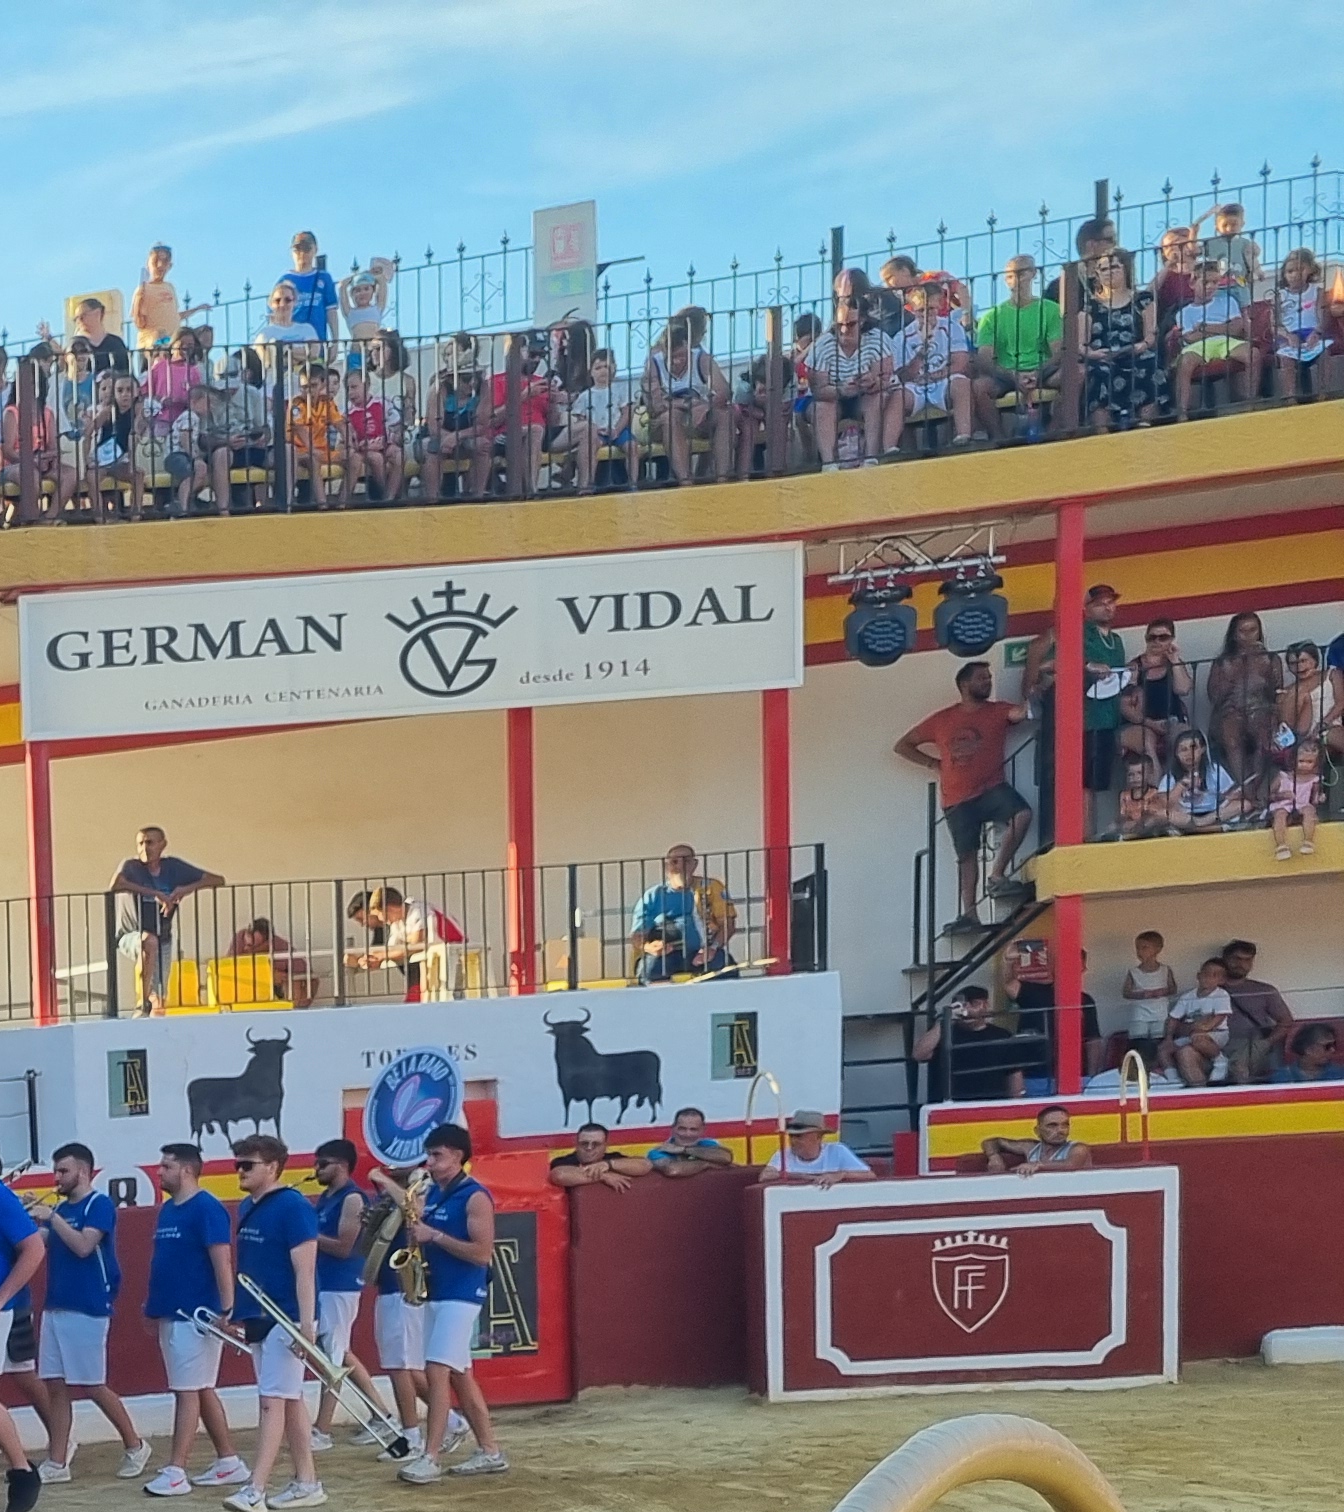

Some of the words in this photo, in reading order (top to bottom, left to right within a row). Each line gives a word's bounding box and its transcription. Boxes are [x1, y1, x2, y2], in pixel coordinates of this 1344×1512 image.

[46, 613, 347, 672] GERMAN
[556, 584, 775, 635] VIDAL
[519, 667, 574, 685] desde
[583, 657, 652, 680] 1914
[144, 693, 253, 712] GANADERIA
[264, 684, 384, 704] CENTENARIA
